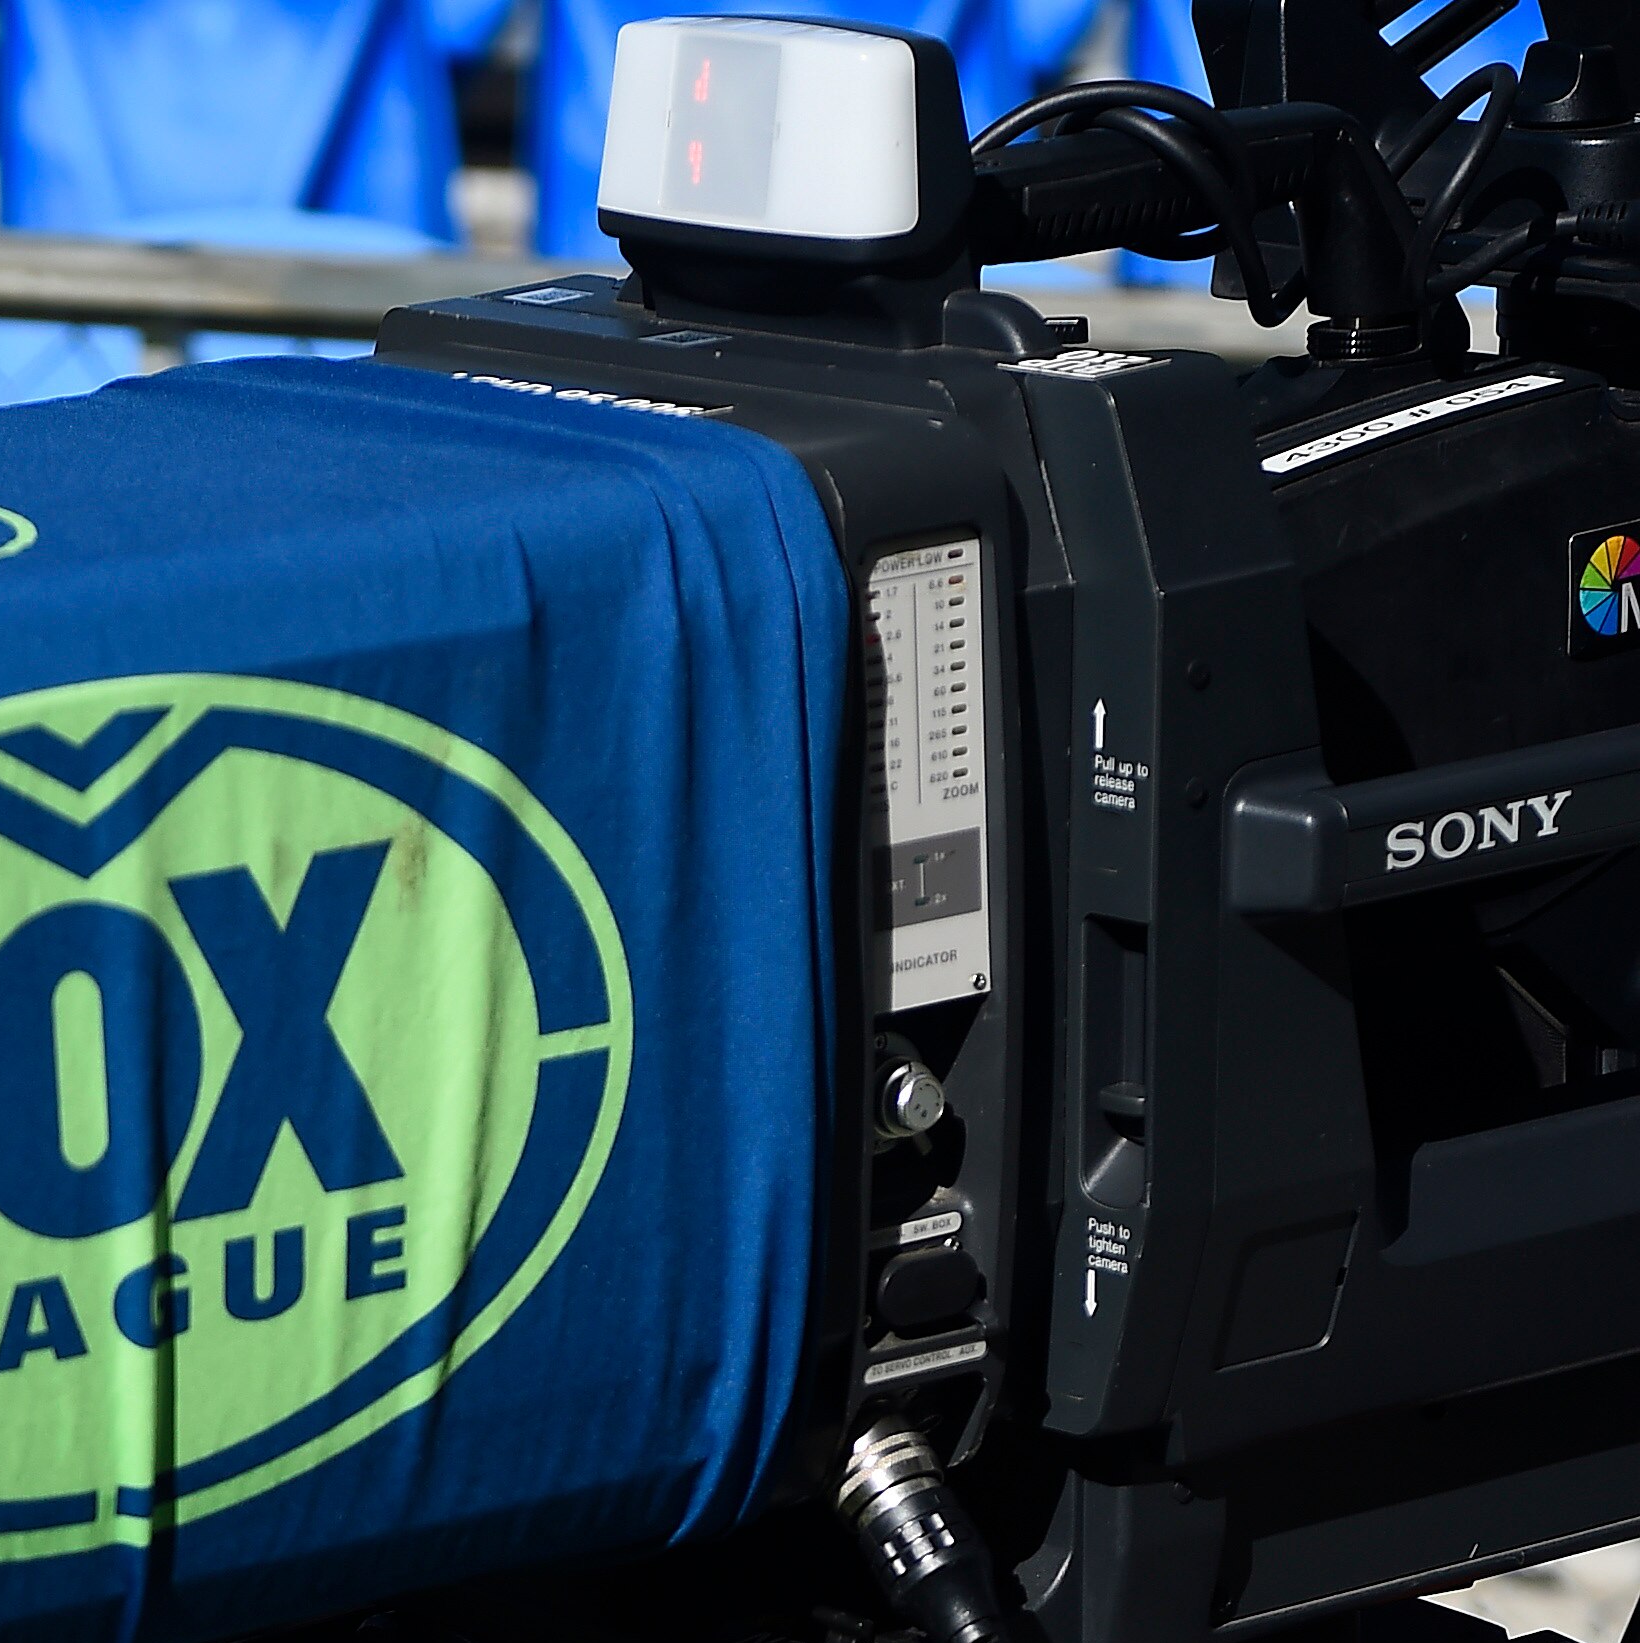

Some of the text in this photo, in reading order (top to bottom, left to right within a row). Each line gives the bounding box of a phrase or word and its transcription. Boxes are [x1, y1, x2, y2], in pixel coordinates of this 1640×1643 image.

[1285, 420, 1394, 463] 4300
[1445, 380, 1530, 407] 054
[873, 551, 944, 574] POWER LOW
[886, 609, 892, 620] 2
[934, 621, 945, 631] 14
[934, 643, 945, 654] 21
[933, 664, 945, 676] 34
[932, 707, 947, 718] 115
[928, 728, 948, 741] 265
[889, 737, 901, 748] 16
[931, 749, 948, 762] 610
[889, 759, 902, 770] 22
[1094, 753, 1149, 777] Pull up to
[1094, 772, 1135, 792] release
[942, 781, 980, 801] ZOOM
[1094, 791, 1136, 809] camera
[1386, 789, 1572, 871] SONY
[931, 1216, 952, 1231] BOX
[1088, 1217, 1131, 1240] Push to
[1088, 1235, 1126, 1256] tighten
[1087, 1254, 1129, 1274] camera
[884, 1359, 912, 1374] SERVO
